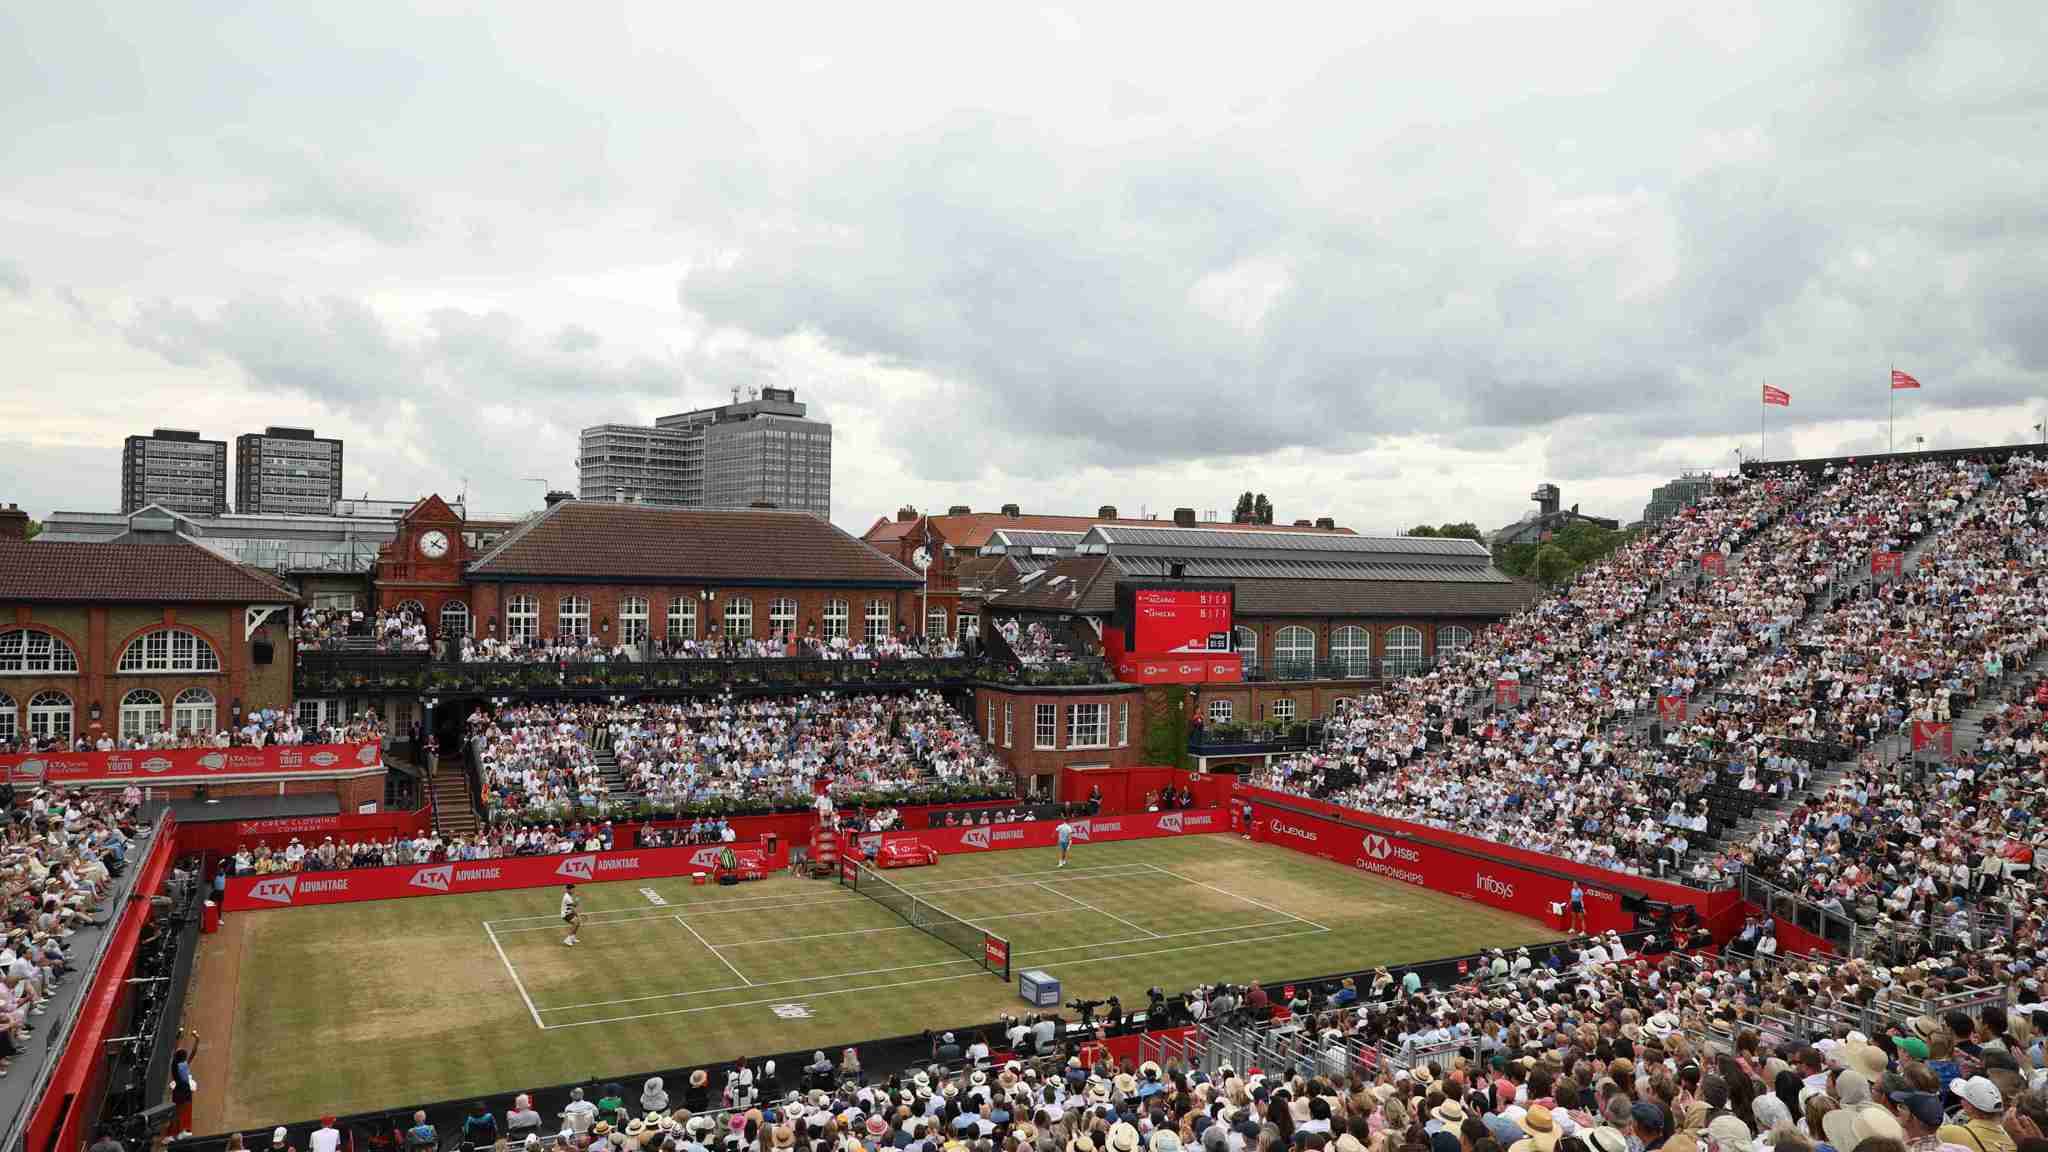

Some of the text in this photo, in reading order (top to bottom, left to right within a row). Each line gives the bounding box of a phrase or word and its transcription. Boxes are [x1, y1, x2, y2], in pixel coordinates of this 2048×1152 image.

[967, 832, 989, 844] LTA
[1281, 825, 1318, 841] LEXUS
[1393, 846, 1420, 862] HSBC
[565, 857, 640, 874] LTA ADVANTAGE
[1355, 857, 1424, 885] CHAMPIONSHIPS
[420, 867, 501, 885] LTA ADVANTAGE
[260, 878, 349, 898] LTA ADVANTAGE
[1475, 872, 1514, 899] Infosys
